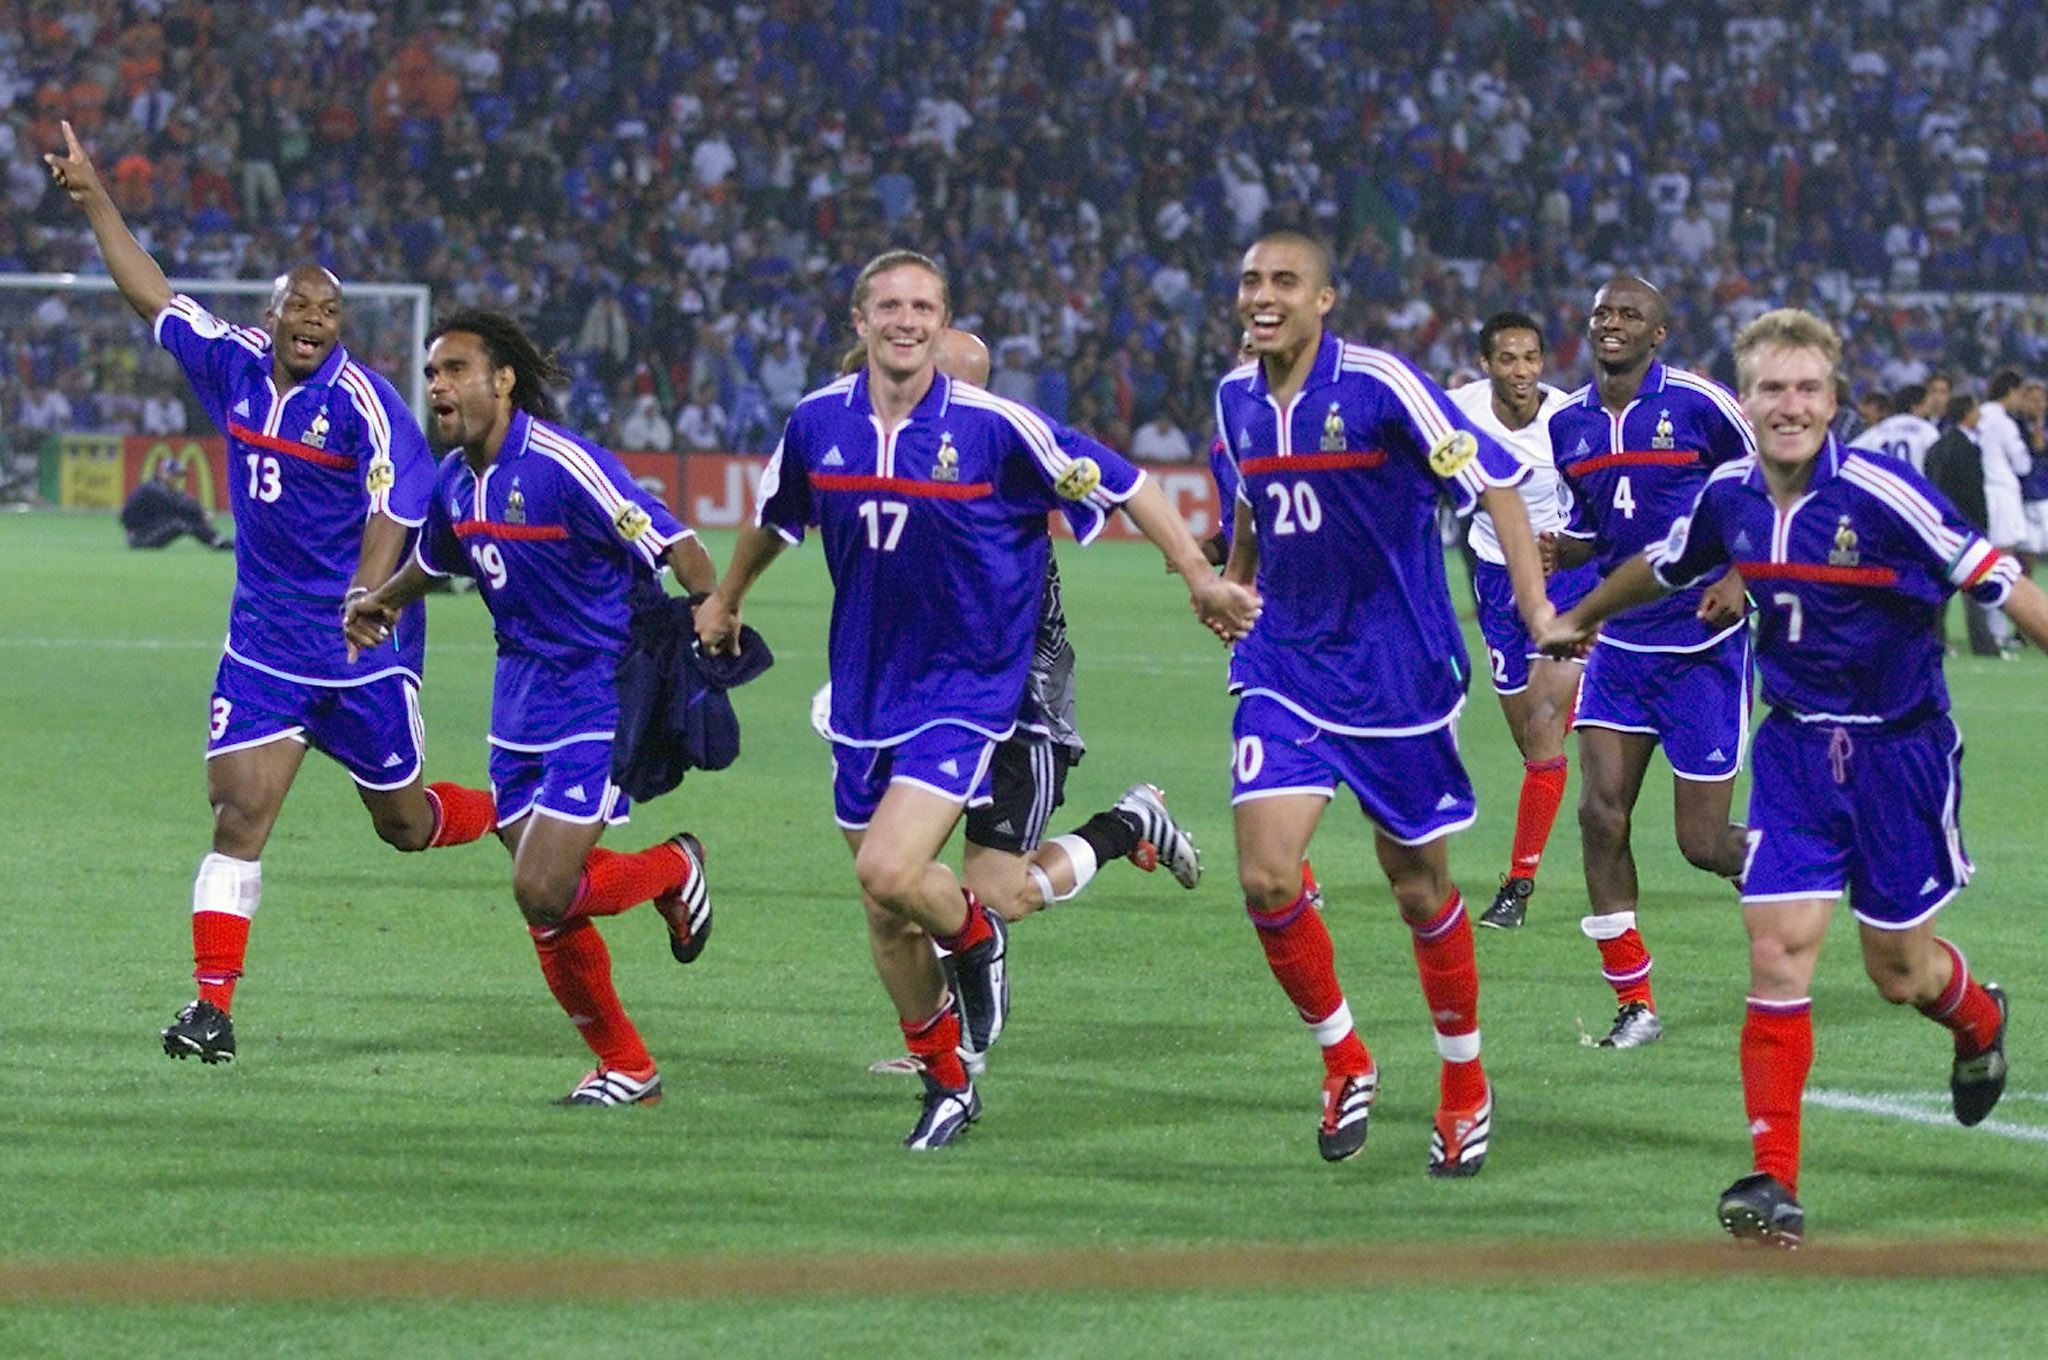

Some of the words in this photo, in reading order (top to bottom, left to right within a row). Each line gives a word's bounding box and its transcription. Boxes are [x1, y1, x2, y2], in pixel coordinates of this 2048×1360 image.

[247, 453, 282, 503] 13
[1613, 476, 1636, 519] 4
[858, 500, 909, 551] 17
[1266, 481, 1322, 534] 20
[471, 543, 508, 589] 19
[1773, 582, 1803, 642] 7
